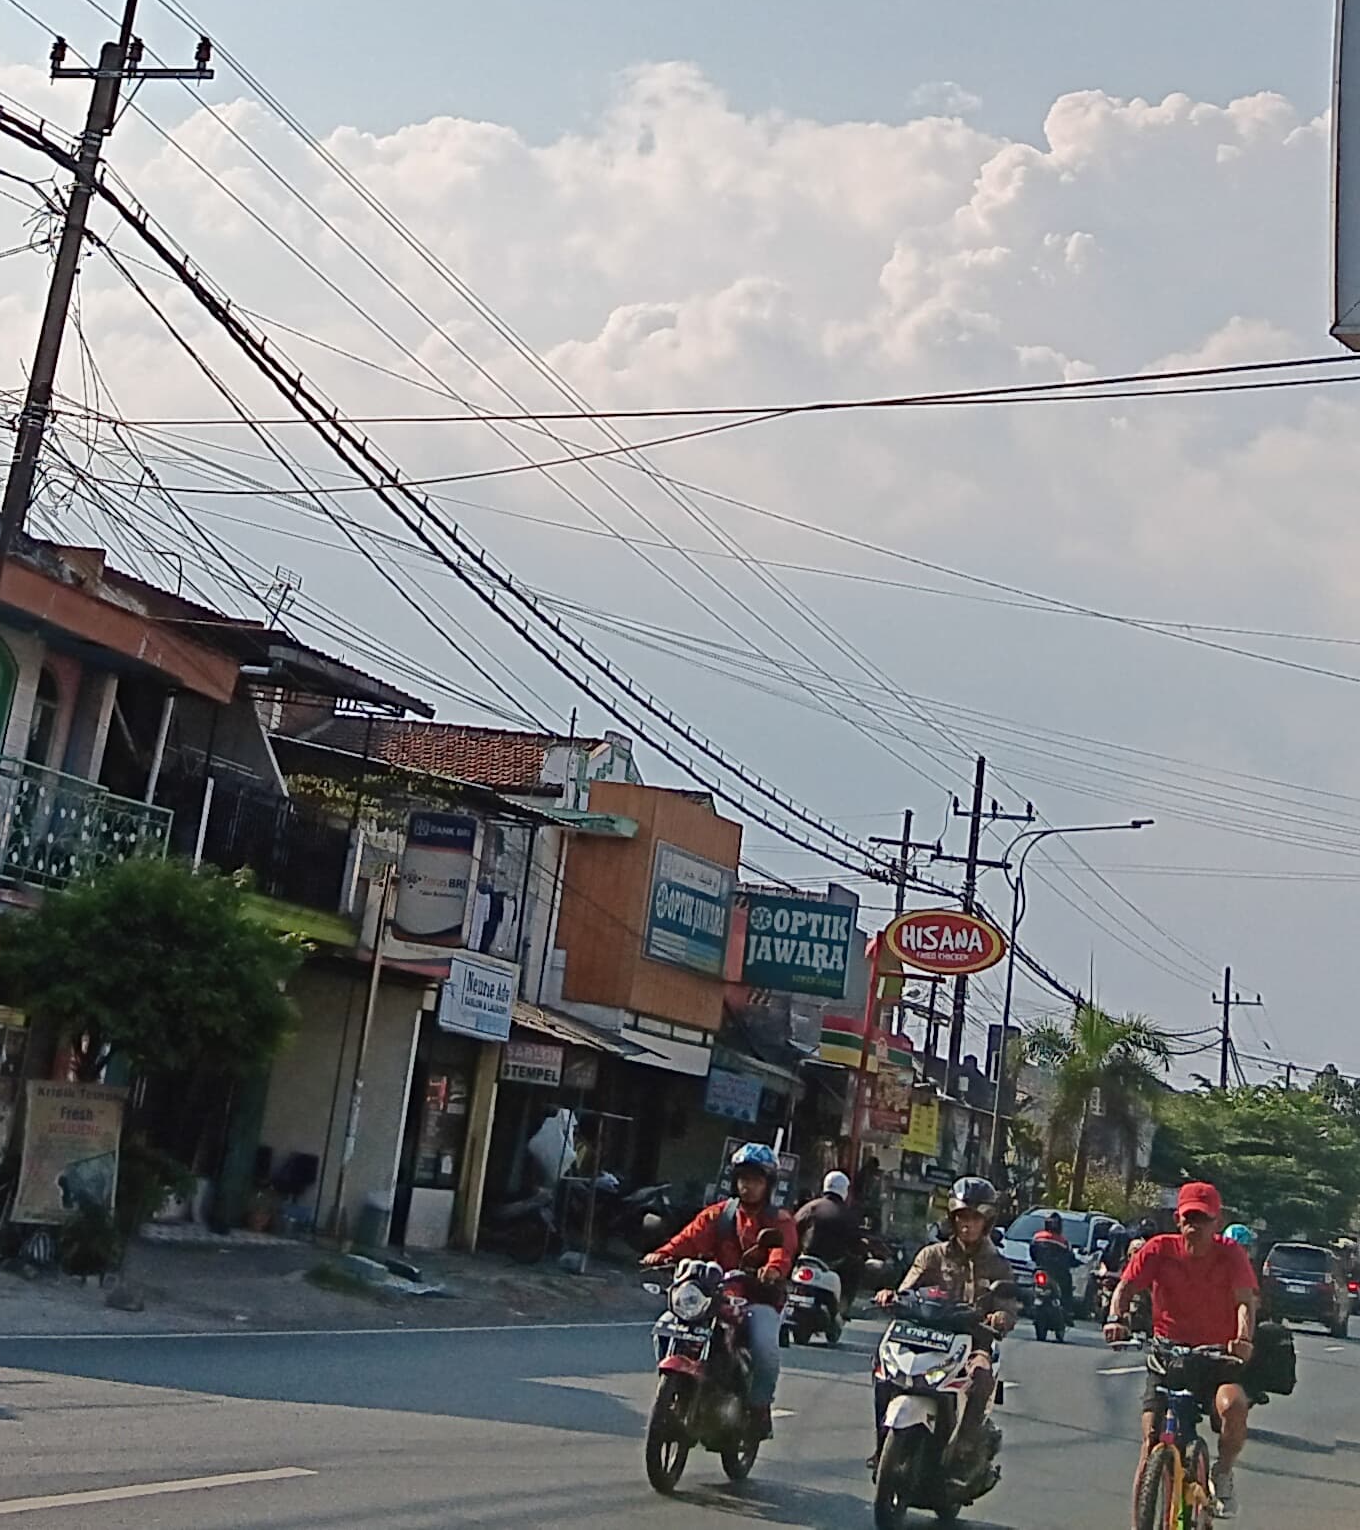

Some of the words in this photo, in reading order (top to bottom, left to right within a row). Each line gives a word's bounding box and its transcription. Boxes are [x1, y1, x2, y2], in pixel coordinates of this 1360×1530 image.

[448, 877, 467, 890] BRI
[773, 908, 850, 942] OPTIK
[901, 924, 984, 953] HISANA
[746, 934, 846, 974] JAWARA
[503, 1063, 559, 1083] STEMPEL
